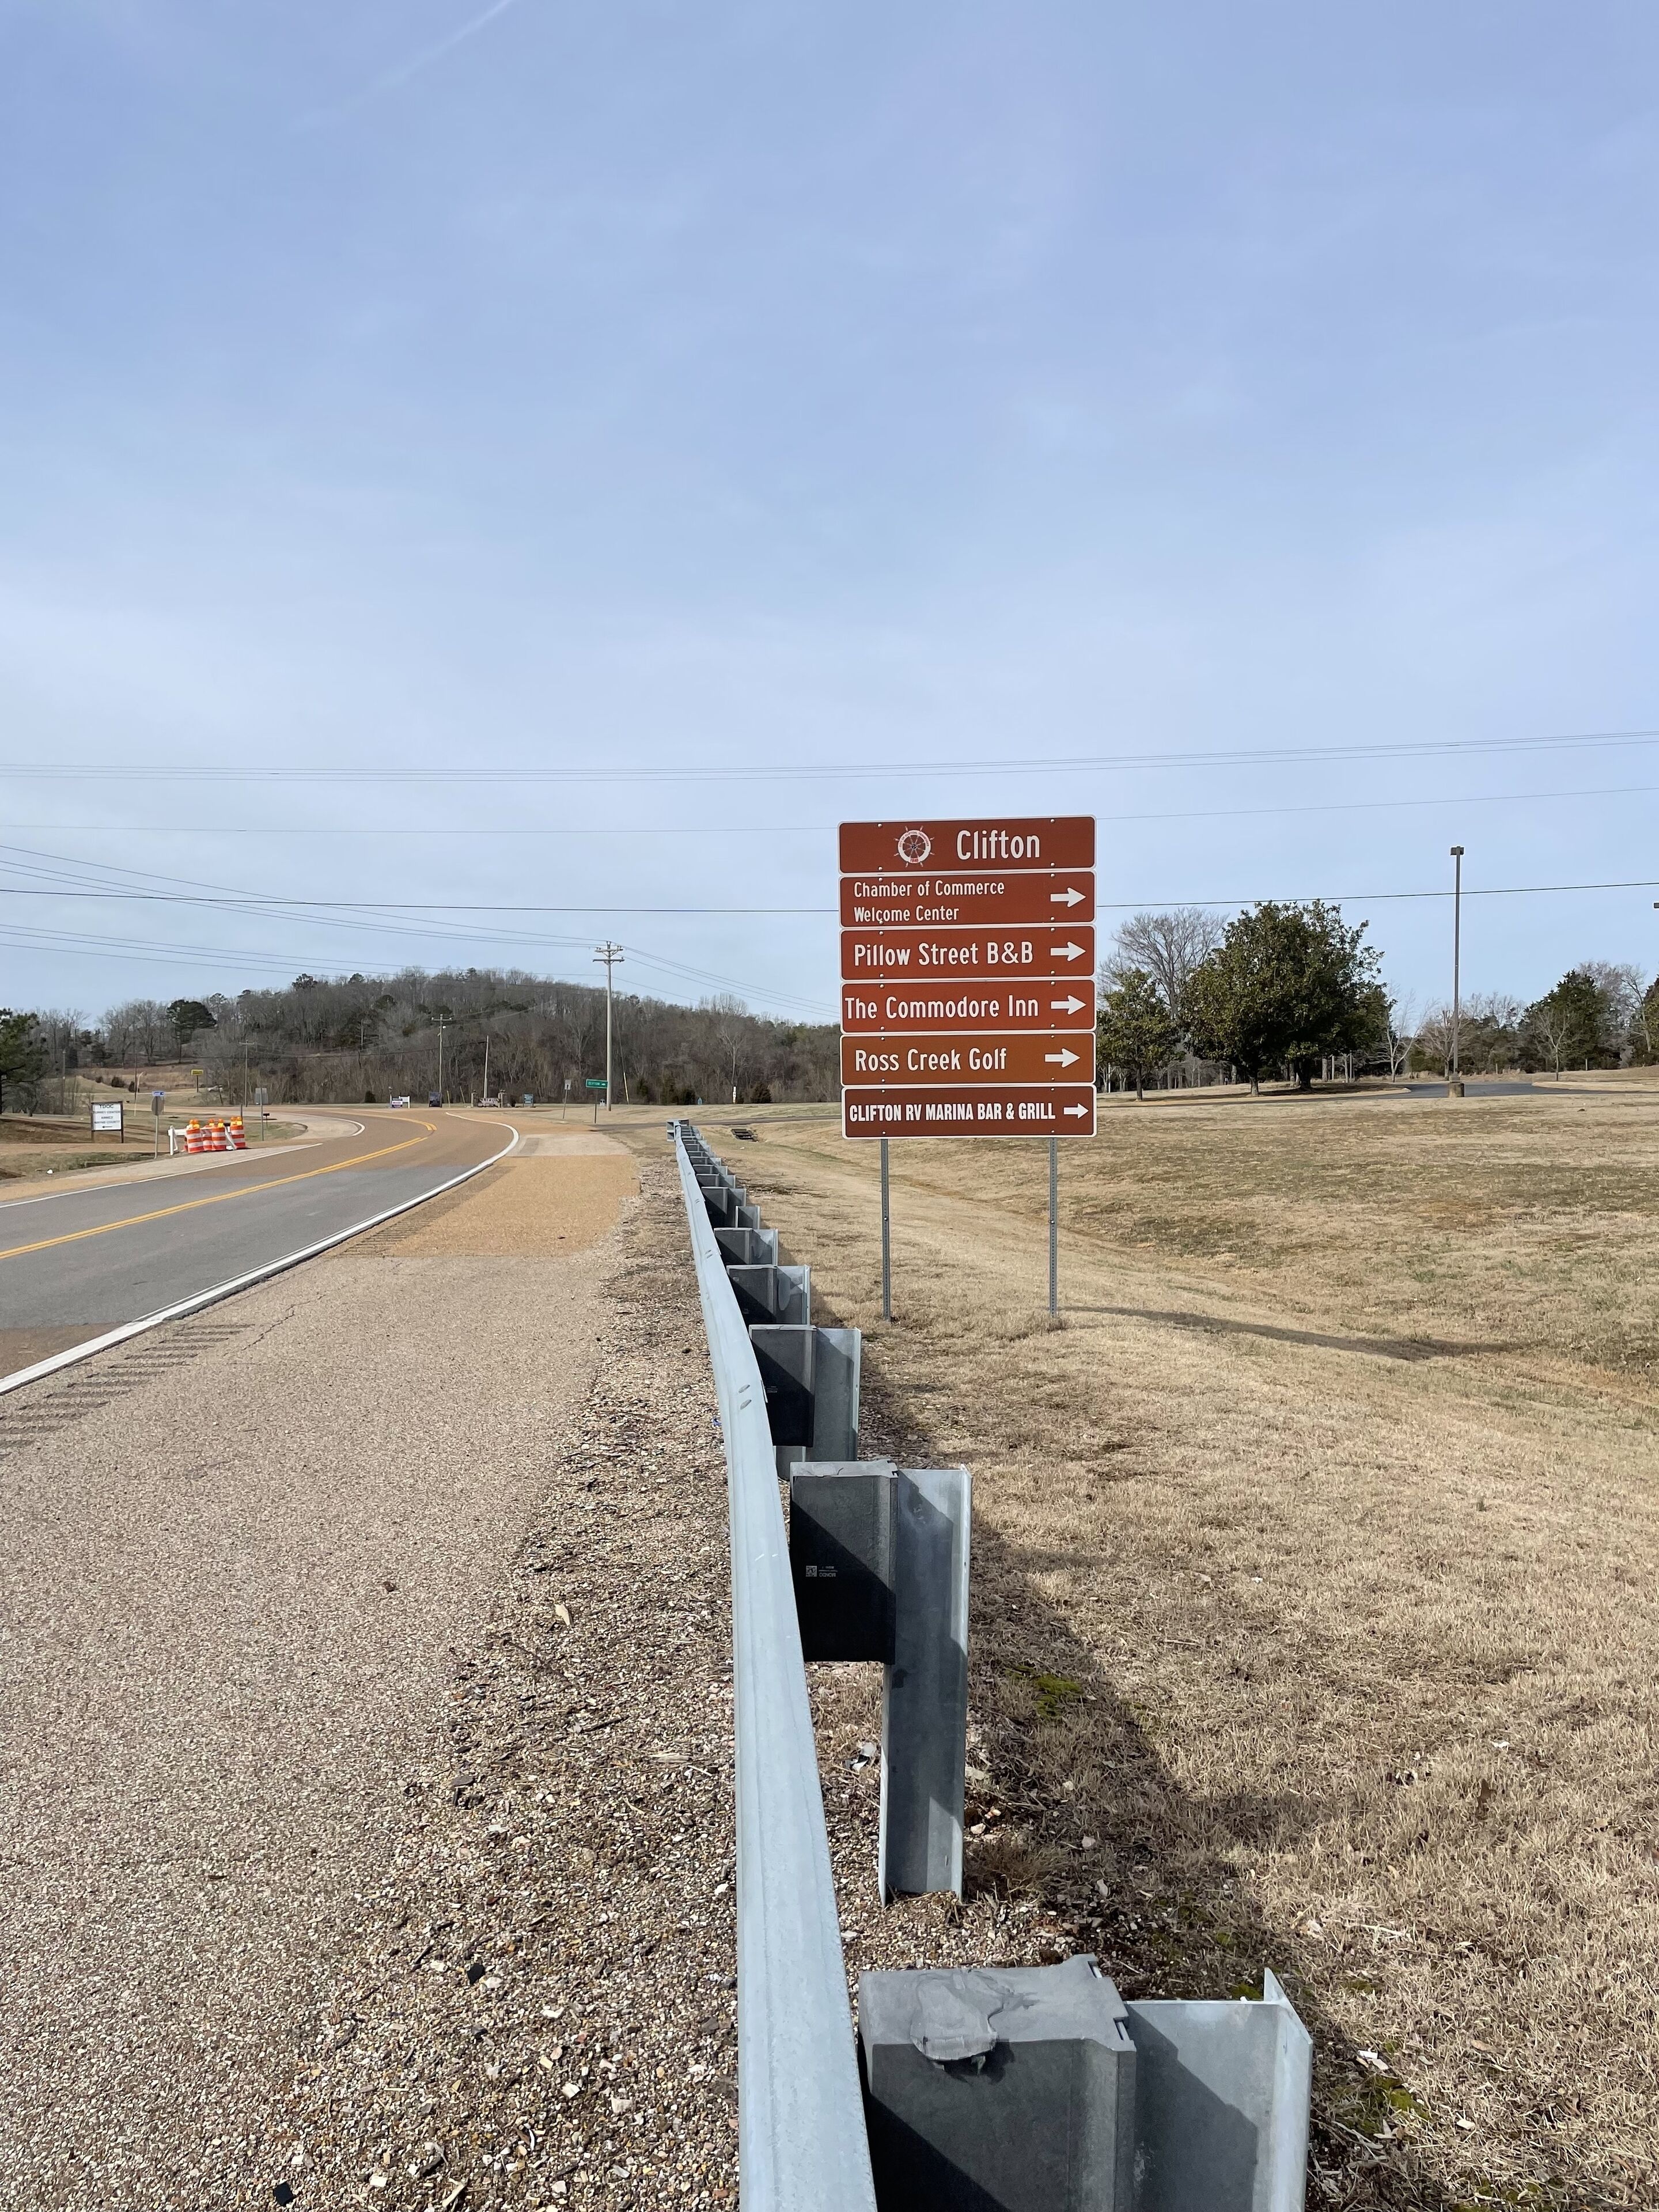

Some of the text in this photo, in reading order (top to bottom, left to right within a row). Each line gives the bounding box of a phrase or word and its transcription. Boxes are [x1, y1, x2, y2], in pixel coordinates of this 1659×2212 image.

[957, 830, 1040, 860] Clifton
[854, 880, 1005, 897] Chamber of Commerce
[854, 905, 959, 922] Welcome Center
[854, 941, 1033, 966] Pillow Street B&B
[844, 995, 1039, 1019] The Commodore Inn
[855, 1047, 1007, 1071] Ross Creek Golf
[849, 1103, 1056, 1122] CLIFTON RV MARINA BAR & GRILL
